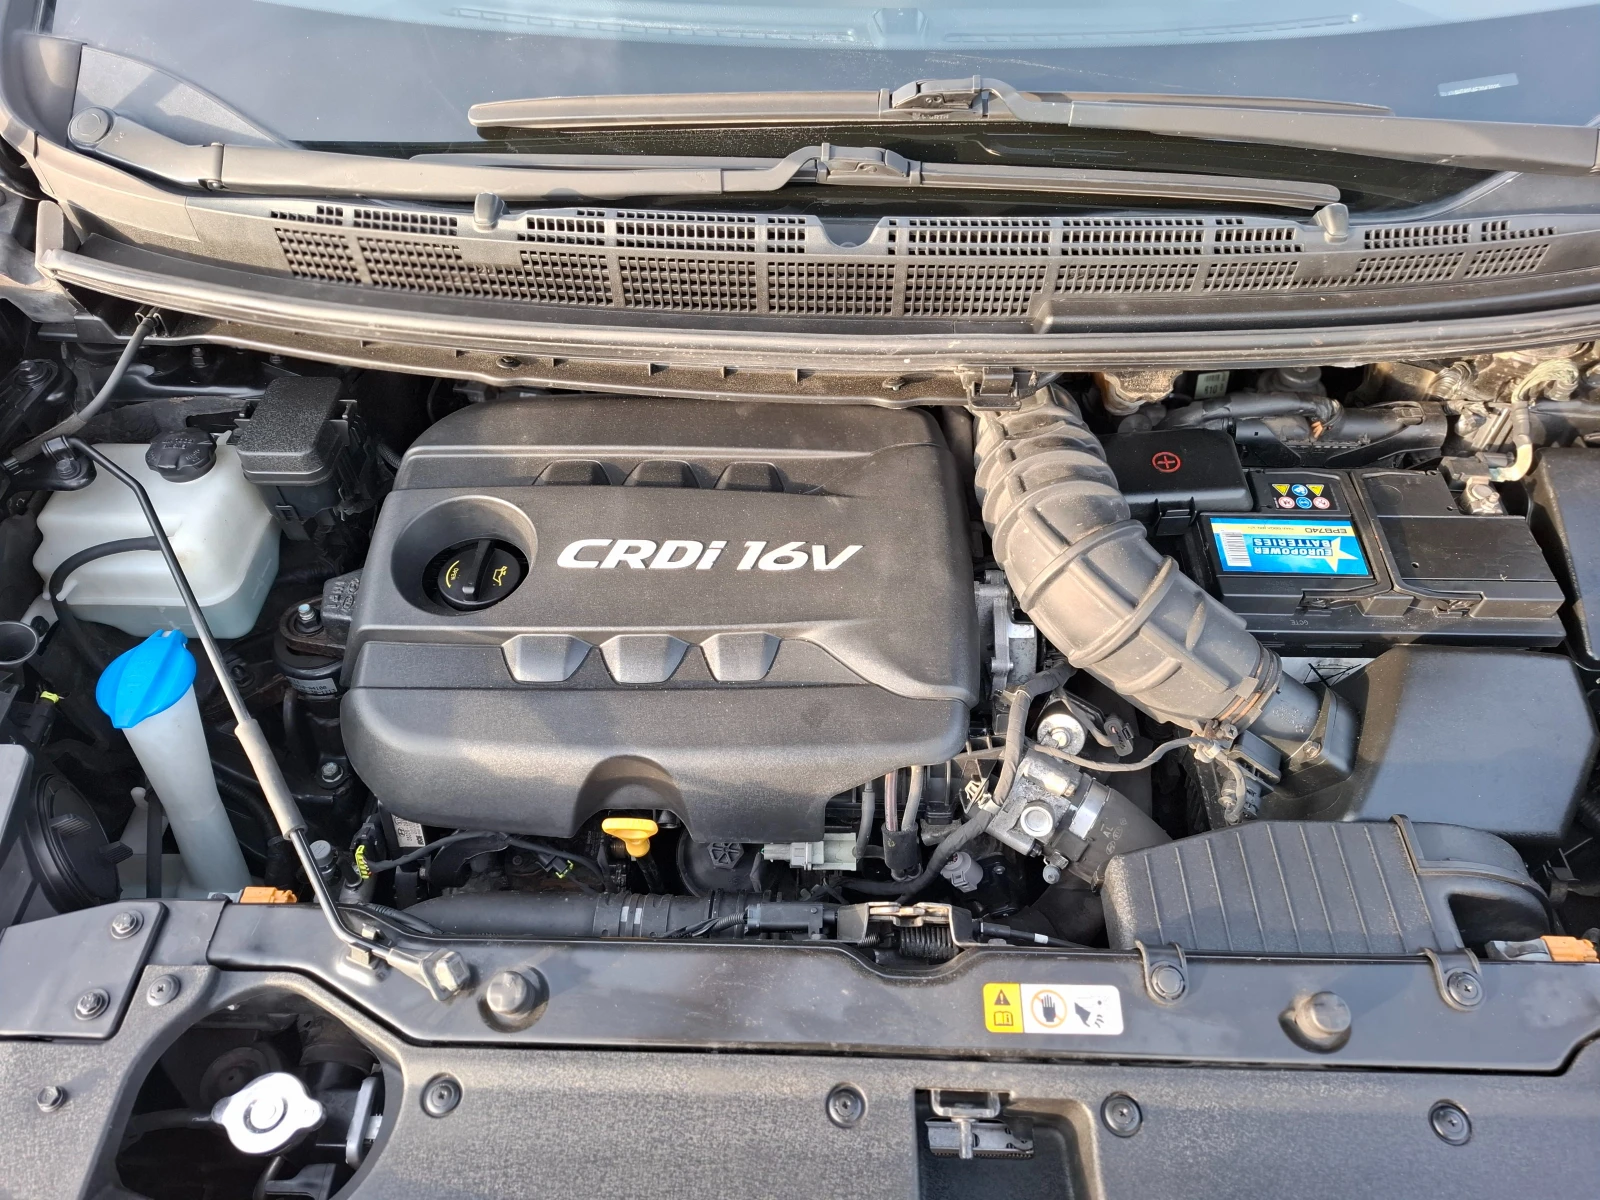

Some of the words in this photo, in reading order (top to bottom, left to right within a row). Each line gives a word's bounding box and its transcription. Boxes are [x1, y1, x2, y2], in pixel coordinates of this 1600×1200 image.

[1254, 538, 1332, 548] BATTERIES
[556, 538, 729, 571] CRDi
[736, 540, 864, 571] 16V
[1254, 547, 1333, 557] EUROPOWER
[451, 567, 460, 581] OPEN
